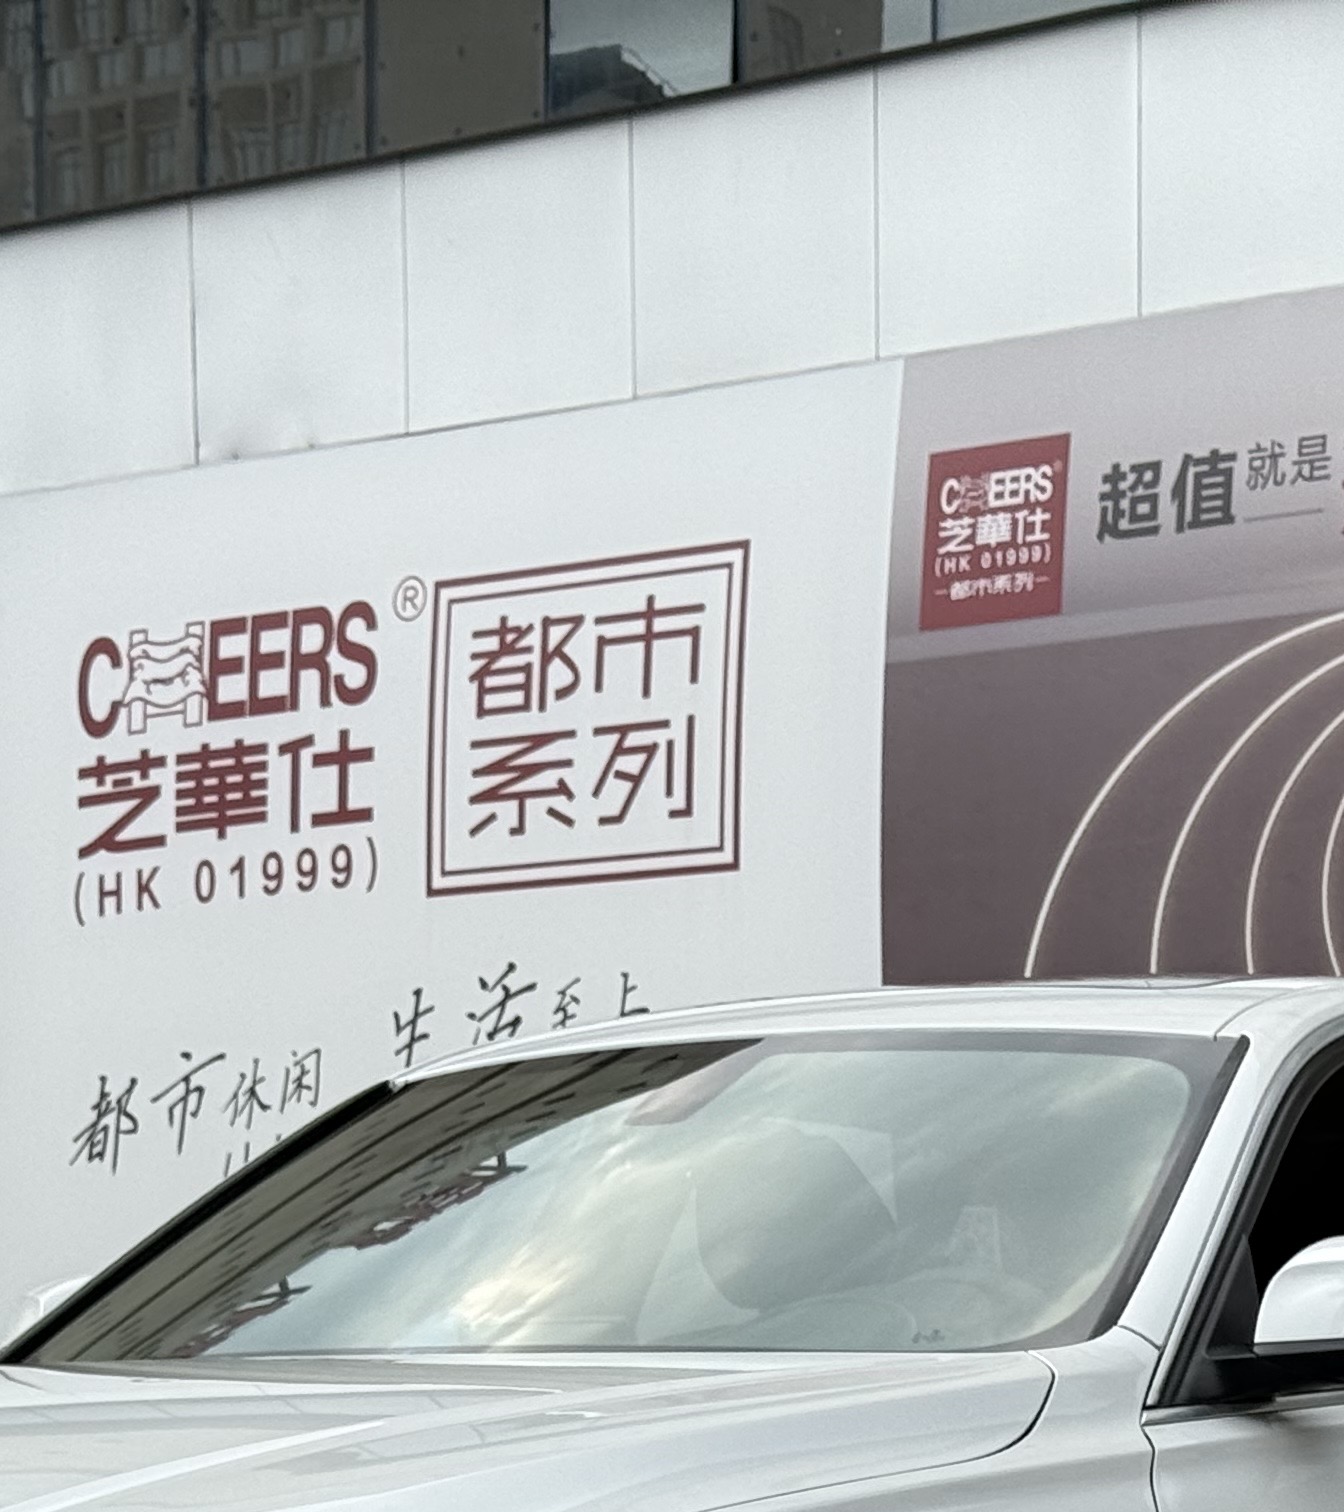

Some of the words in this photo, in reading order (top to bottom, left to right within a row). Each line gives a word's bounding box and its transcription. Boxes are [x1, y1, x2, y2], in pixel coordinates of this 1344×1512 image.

[937, 507, 1052, 555] 芝華仕
[940, 465, 1054, 515] CHEERS
[78, 600, 378, 739] CHEERS
[469, 595, 706, 719] 都市
[77, 728, 376, 860] 芝華仕
[469, 715, 696, 838] 系列
[74, 865, 162, 927] (HK
[193, 836, 379, 905] 01999)
[69, 1048, 324, 1175] 都市休闲
